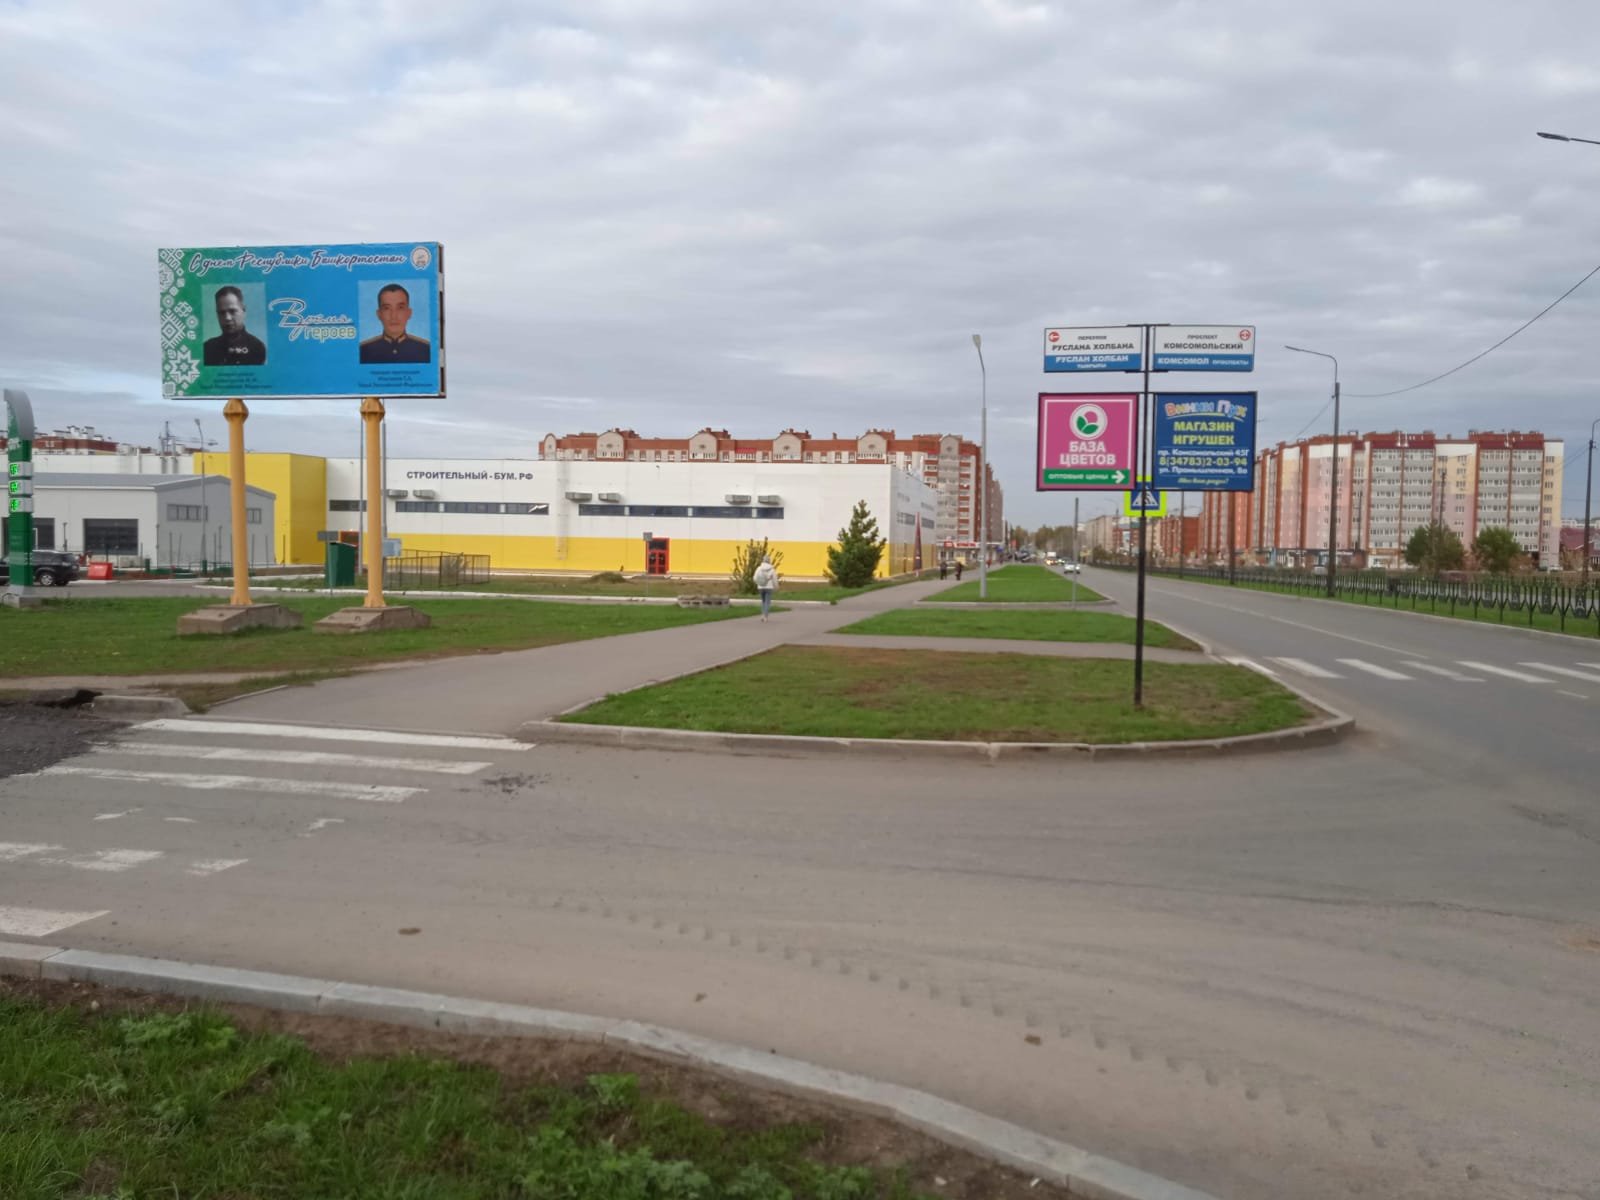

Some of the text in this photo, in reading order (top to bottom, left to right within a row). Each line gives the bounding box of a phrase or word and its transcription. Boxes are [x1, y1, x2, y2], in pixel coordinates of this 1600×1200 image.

[189, 252, 202, 274] С
[235, 251, 308, 274] Республики
[311, 249, 406, 272] Башкортостан
[304, 326, 356, 343] героев
[1052, 342, 1134, 351] РУСЛАНА ХОЛБАНА
[1164, 342, 1243, 350] КОМСОМОЛЬСКИЙ
[1055, 354, 1129, 364] РУСЛАН ХОЛБАН
[1158, 357, 1210, 365] КОМСОМОЛ
[1173, 421, 1235, 432] МАГАЗИН
[1173, 434, 1235, 445] ИГРУШЕК
[1069, 441, 1106, 453] БАЗА
[1059, 453, 1116, 468] ЦВЕТОВ
